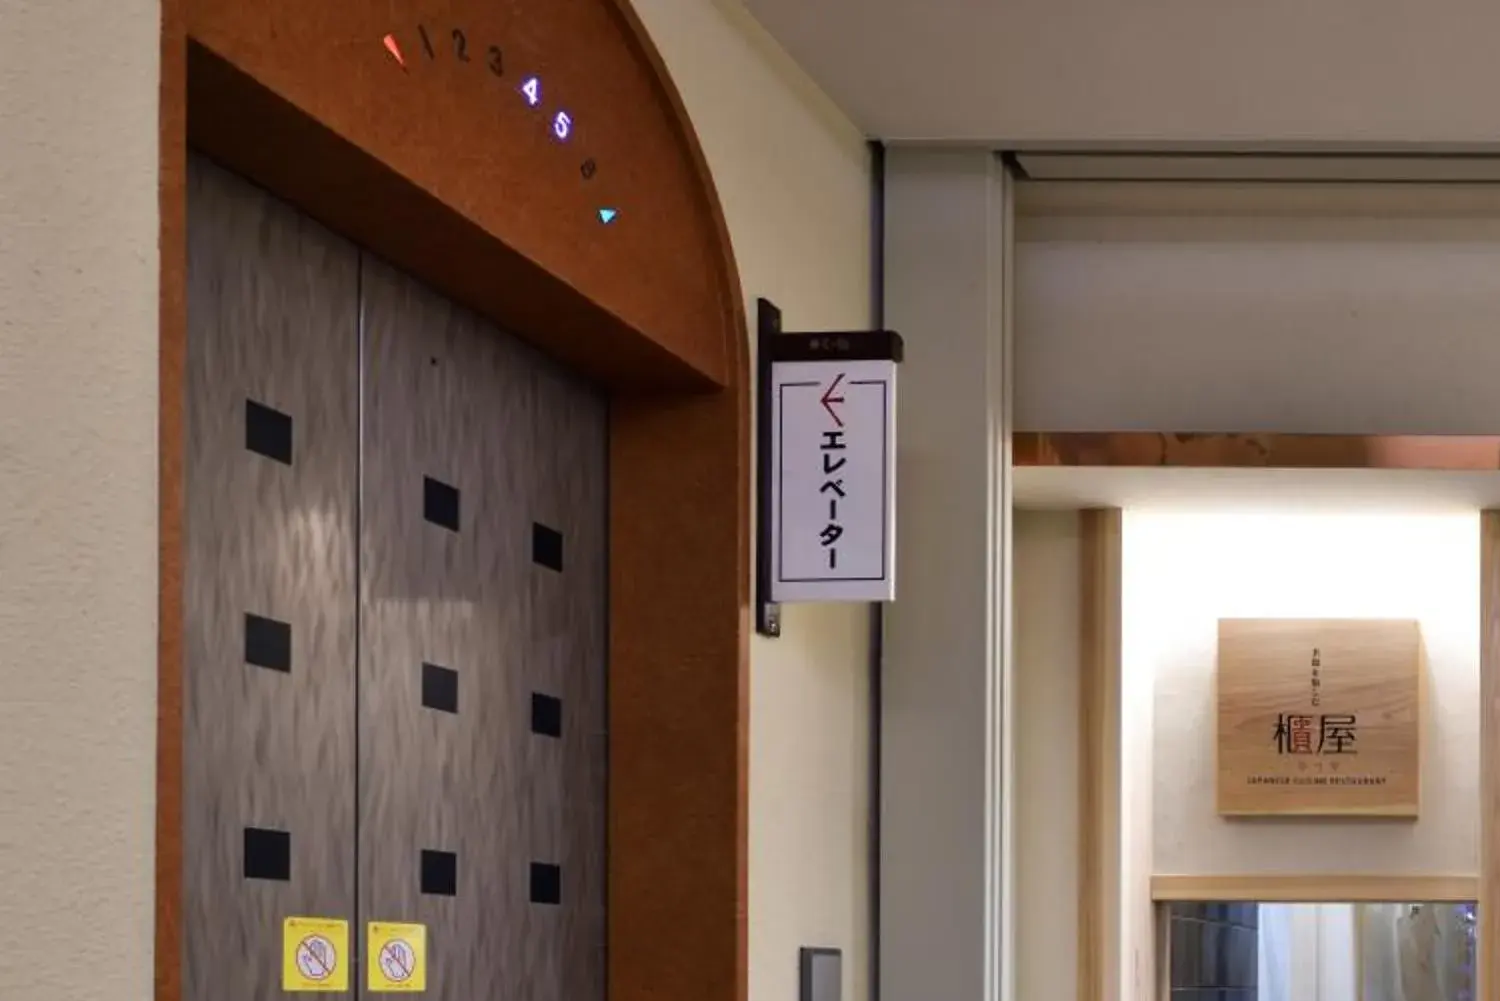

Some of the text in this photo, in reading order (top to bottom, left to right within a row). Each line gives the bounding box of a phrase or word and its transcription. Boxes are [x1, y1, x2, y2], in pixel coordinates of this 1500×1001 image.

[452, 28, 470, 62] 2
[488, 45, 504, 77] 3
[522, 77, 538, 105] 4
[554, 111, 572, 139] 5
[820, 431, 846, 569] エレベーター
[1273, 713, 1358, 755] 櫃屋
